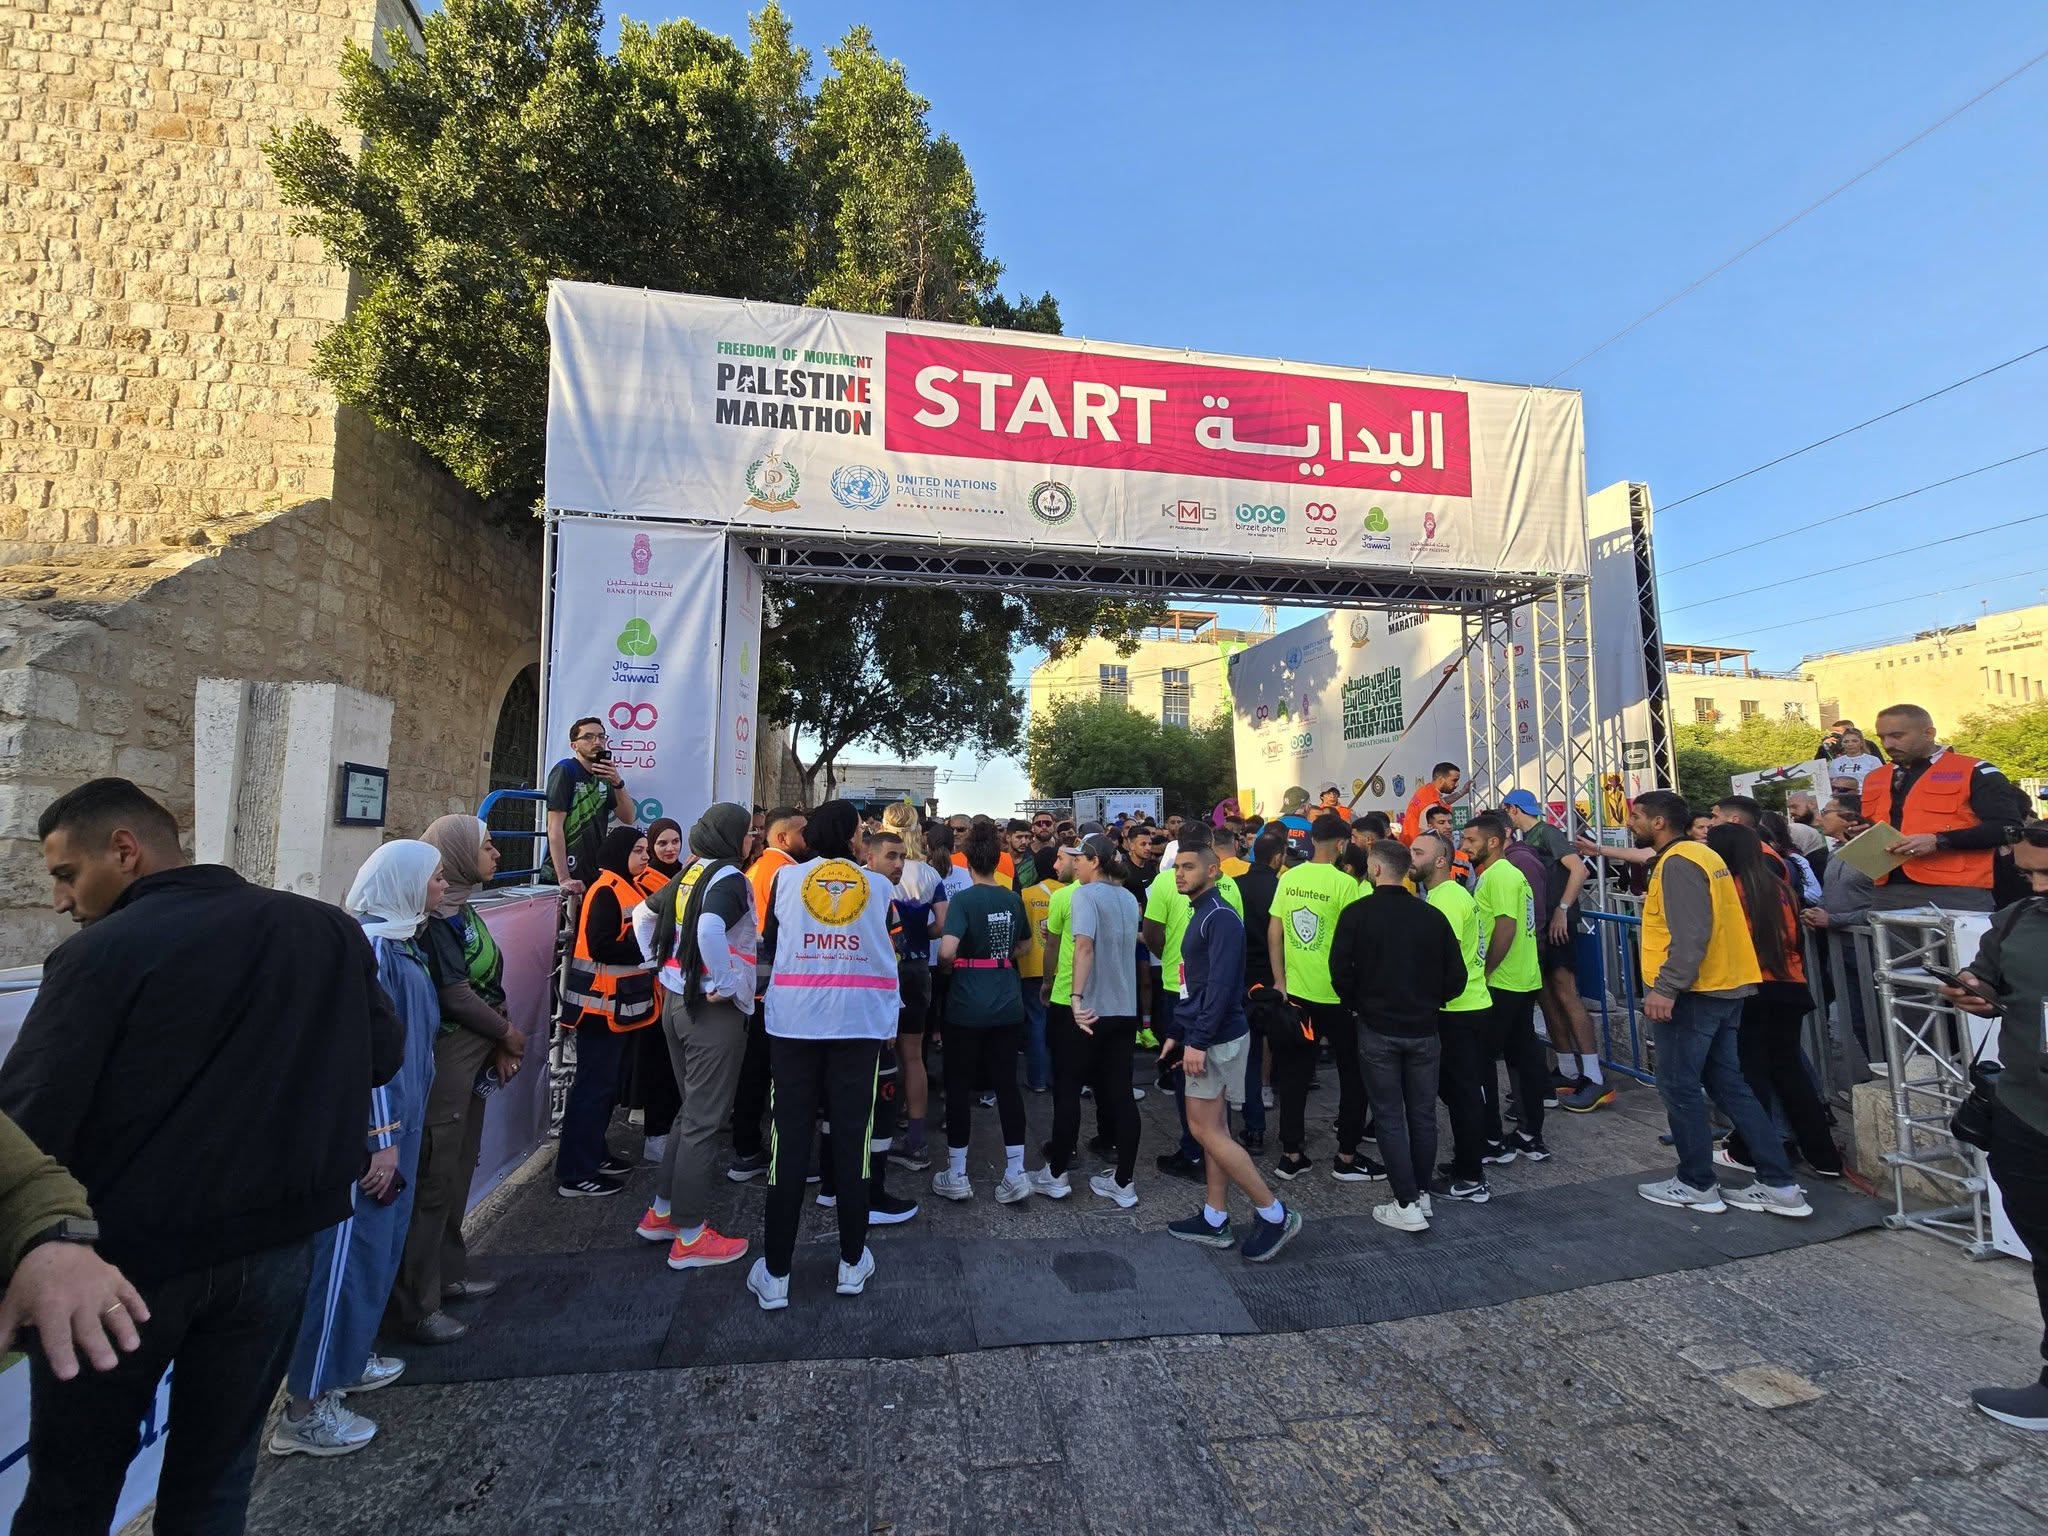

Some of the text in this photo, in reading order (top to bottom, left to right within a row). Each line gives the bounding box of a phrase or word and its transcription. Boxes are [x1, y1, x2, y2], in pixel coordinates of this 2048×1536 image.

[717, 341, 873, 368] FREEDOM OF MOVEMENT
[717, 362, 871, 405] PALESTINE
[912, 365, 1167, 445] START
[715, 398, 872, 436] MARATHON
[1194, 394, 1445, 483] البداية
[896, 473, 998, 491] UNITED NATIONS
[896, 485, 961, 500] PALESTINE
[1161, 502, 1217, 522] KMG
[1237, 504, 1284, 524] bpc
[1235, 523, 1287, 533] birzeit pharm
[1361, 542, 1391, 550] Jawwal
[606, 578, 649, 587] فلسطين
[638, 589, 673, 598] PALESTINE
[1388, 612, 1430, 635] MARATHON
[612, 672, 660, 684] Jawwal
[1343, 702, 1402, 729] PALESTINE
[1344, 717, 1404, 741] MARATHON
[1346, 736, 1392, 749] INTERNATIONAL
[945, 881, 962, 890] ON'T
[1285, 886, 1331, 902] Volunteer
[823, 916, 841, 924] Medical
[803, 933, 860, 951] PMRS
